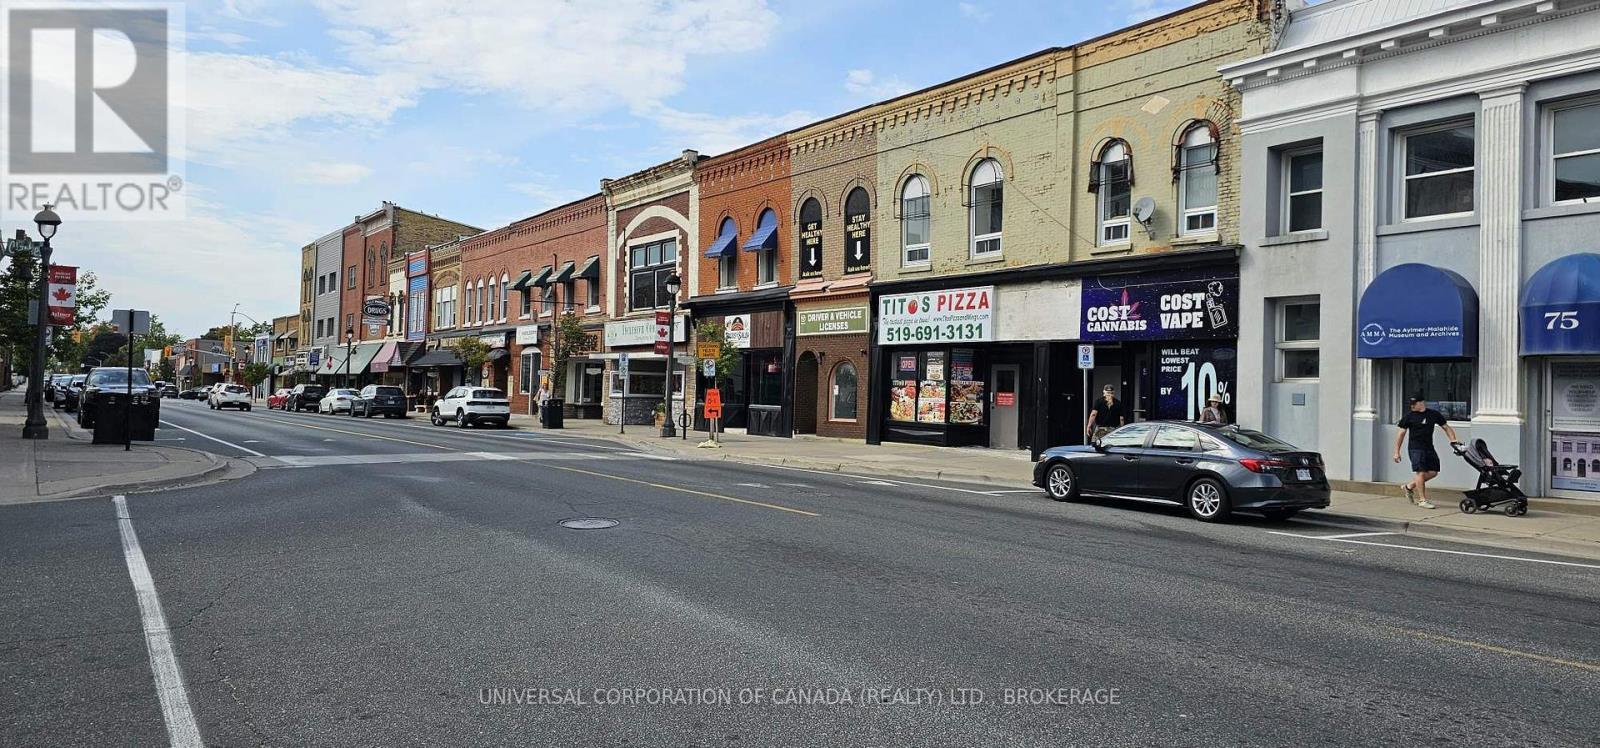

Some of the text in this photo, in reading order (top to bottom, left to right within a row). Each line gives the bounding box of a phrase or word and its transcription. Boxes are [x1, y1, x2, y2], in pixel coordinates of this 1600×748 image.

[852, 214, 866, 223] STAY
[846, 221, 871, 232] HEALTHY
[801, 229, 823, 239] HEALTHY
[851, 230, 867, 239] HERE
[937, 291, 989, 312] PIZZA
[1160, 292, 1206, 311] COST
[367, 306, 387, 314] DRUGS
[1087, 306, 1131, 321] COST
[807, 313, 829, 322] DRIVER
[835, 310, 862, 320] VEHICLE
[1160, 311, 1203, 329] VAPE
[1544, 310, 1580, 330] 75
[819, 322, 849, 331] LICENSES
[1087, 320, 1147, 332] CANNABIS
[886, 323, 983, 341] 519-691-3131
[1180, 347, 1200, 355] BEAT
[901, 359, 914, 368] OPEN
[1161, 365, 1182, 373] PRICE
[1160, 387, 1173, 395] BY
